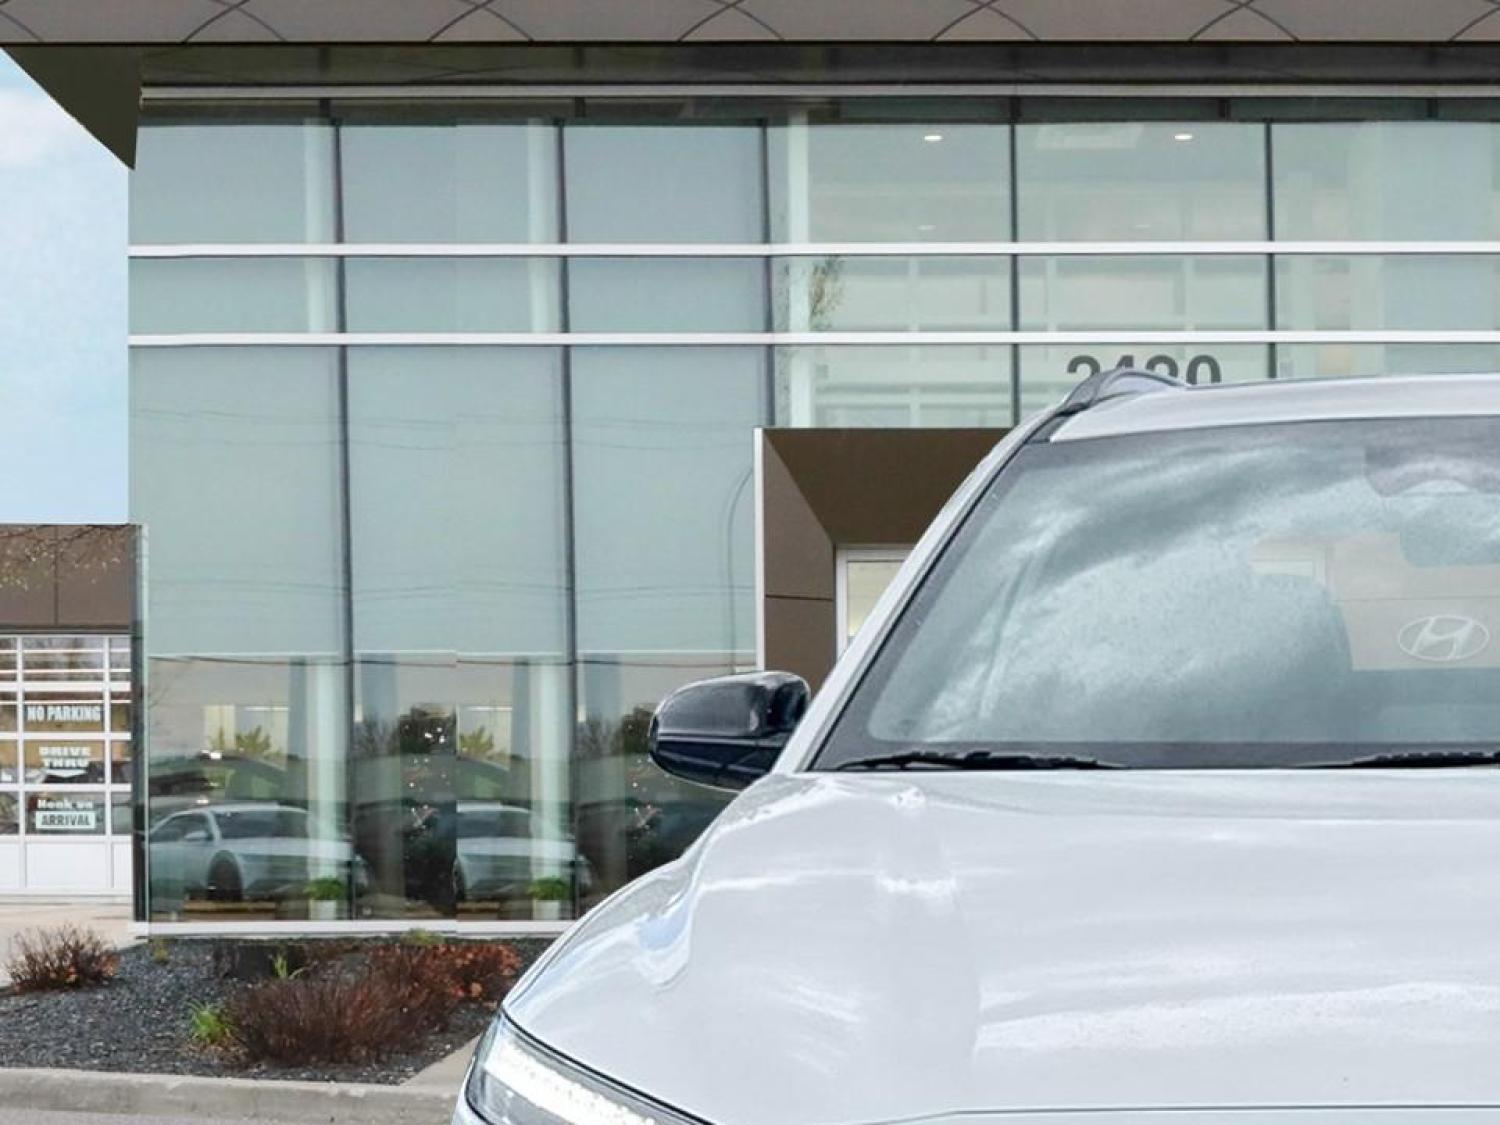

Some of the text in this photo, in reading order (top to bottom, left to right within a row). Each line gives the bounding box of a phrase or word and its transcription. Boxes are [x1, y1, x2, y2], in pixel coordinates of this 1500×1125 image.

[1067, 354, 1222, 385] 20
[28, 706, 101, 722] NO PARKING
[38, 746, 91, 758] DRIVE
[43, 758, 90, 769] THRU
[41, 815, 91, 827] ARRIVAL
